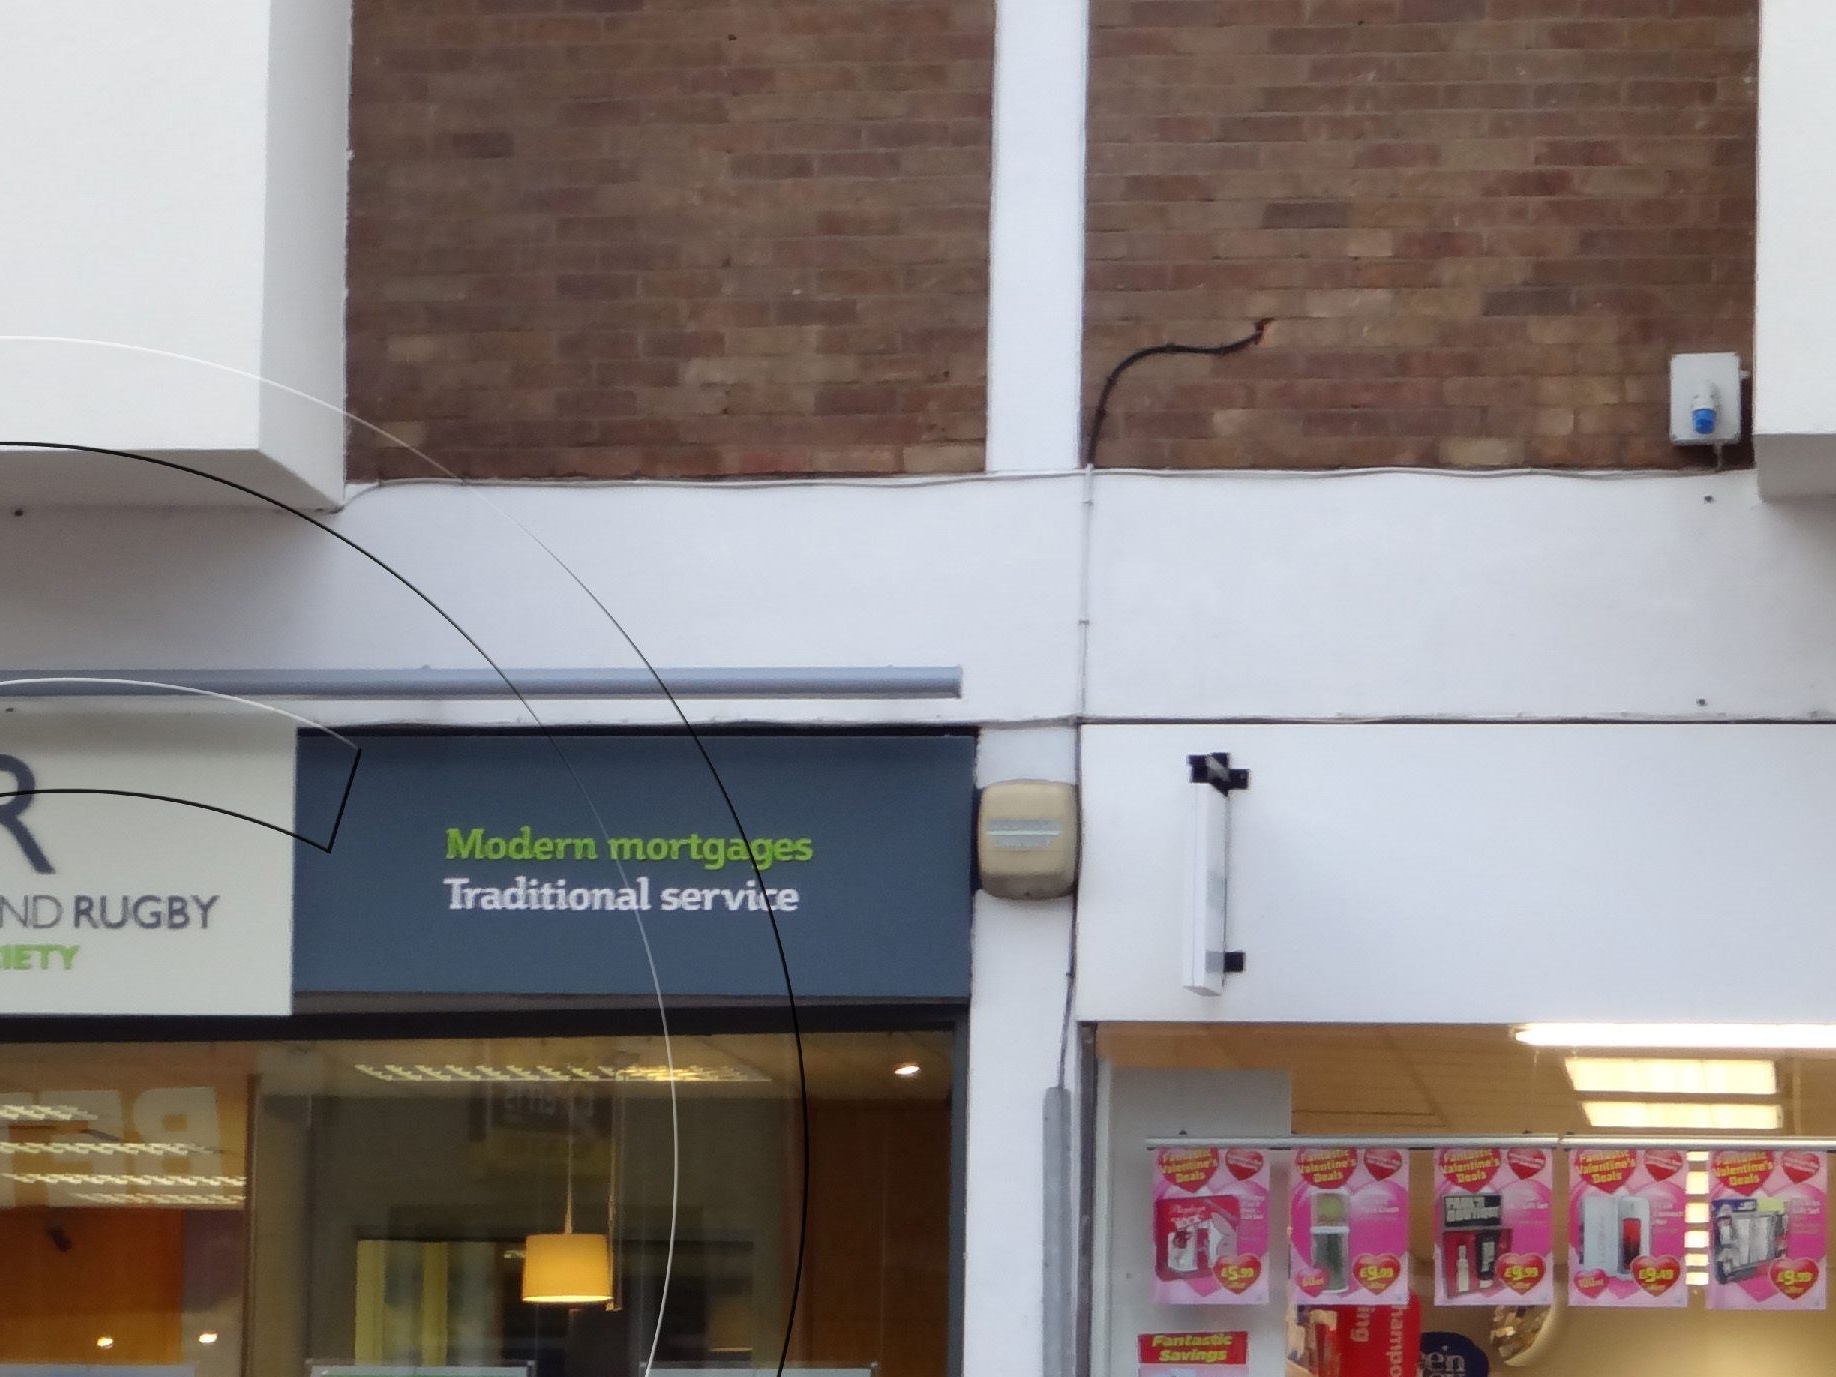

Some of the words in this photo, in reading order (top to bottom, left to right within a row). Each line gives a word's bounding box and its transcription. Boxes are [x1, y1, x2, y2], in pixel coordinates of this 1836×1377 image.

[445, 827, 598, 861] Modern
[608, 830, 814, 869] mortgages
[443, 876, 651, 911] Traditional
[661, 879, 800, 911] service
[74, 895, 220, 930] RUGBY
[1176, 1172, 1205, 1183] Deals
[1314, 1171, 1343, 1183] Deals
[1456, 1171, 1486, 1183] Deals
[1592, 1171, 1622, 1183] Deals
[1729, 1174, 1760, 1186] Deals
[1152, 1333, 1234, 1347] Fantastic
[1159, 1349, 1228, 1363] Savings
